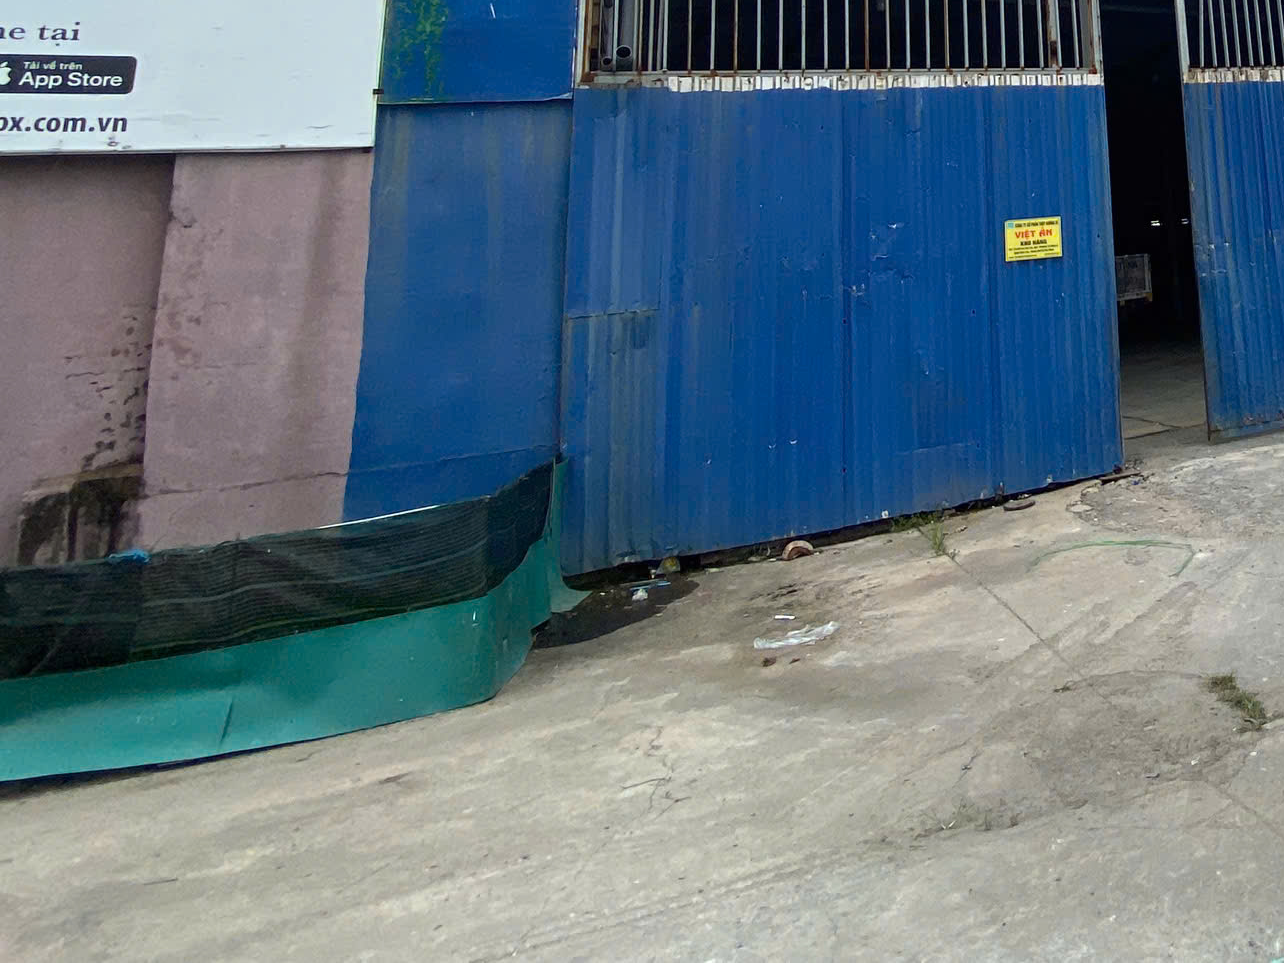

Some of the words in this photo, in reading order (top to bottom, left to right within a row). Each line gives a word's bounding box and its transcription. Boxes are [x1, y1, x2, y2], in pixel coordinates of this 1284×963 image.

[39, 21, 80, 46] tại
[19, 72, 62, 89] App
[67, 72, 123, 87] Store
